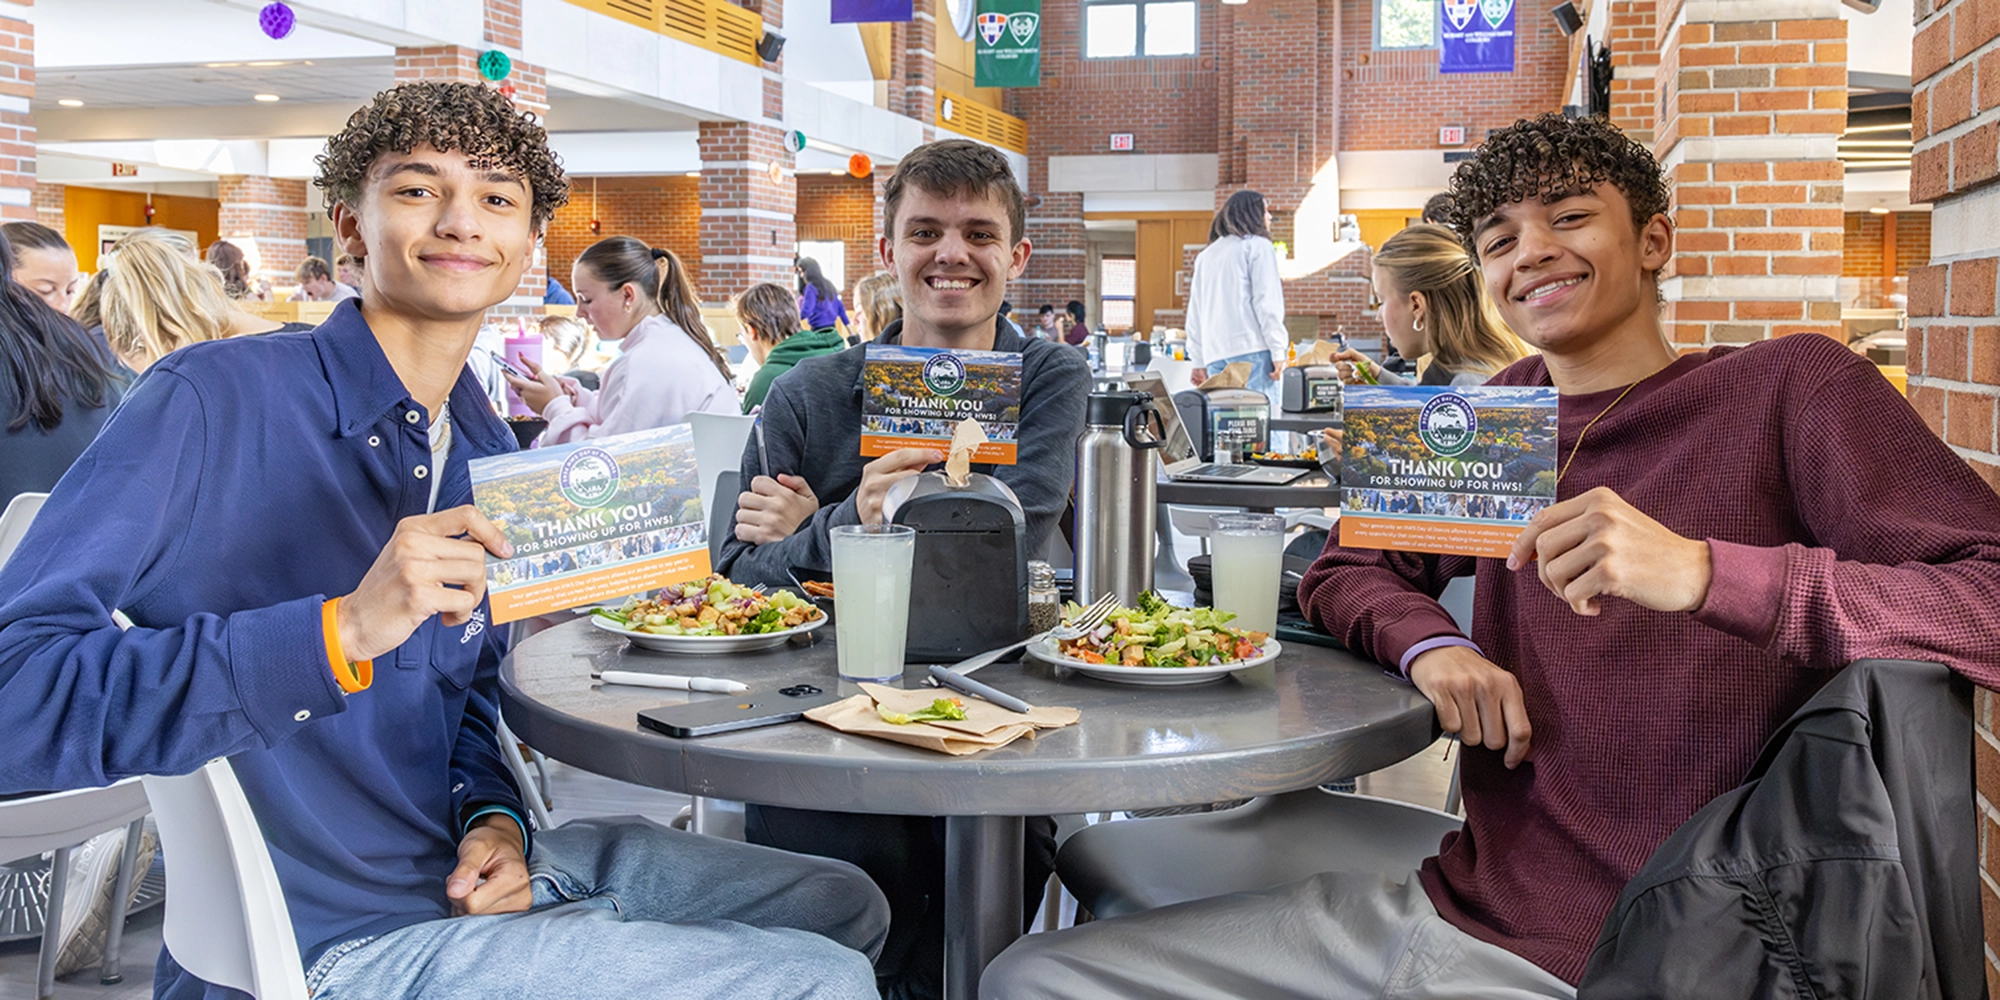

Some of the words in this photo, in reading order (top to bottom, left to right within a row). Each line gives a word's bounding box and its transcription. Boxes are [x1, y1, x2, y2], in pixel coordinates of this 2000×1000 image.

[1114, 136, 1130, 148] EXIT
[1444, 130, 1460, 142] EXIT
[116, 163, 136, 176] EXIT
[900, 396, 948, 410] THANK
[952, 399, 982, 411] YOU
[903, 408, 942, 417] SHOWING
[1460, 402, 1474, 426] DONORS
[600, 452, 616, 474] DONORS
[1389, 459, 1456, 477] THANK
[1460, 461, 1503, 479] YOU
[1370, 476, 1391, 485] FOR
[1394, 476, 1446, 488] SHOWING
[1449, 479, 1464, 489] UP
[1467, 480, 1488, 490] FOR
[1492, 481, 1522, 492] HWS!
[534, 510, 606, 538] THANK
[609, 502, 652, 523] YOU
[516, 542, 539, 554] FOR
[543, 530, 598, 548] SHOWING
[601, 526, 616, 536] UP
[619, 521, 641, 534] FOR
[644, 515, 673, 528] HWS!
